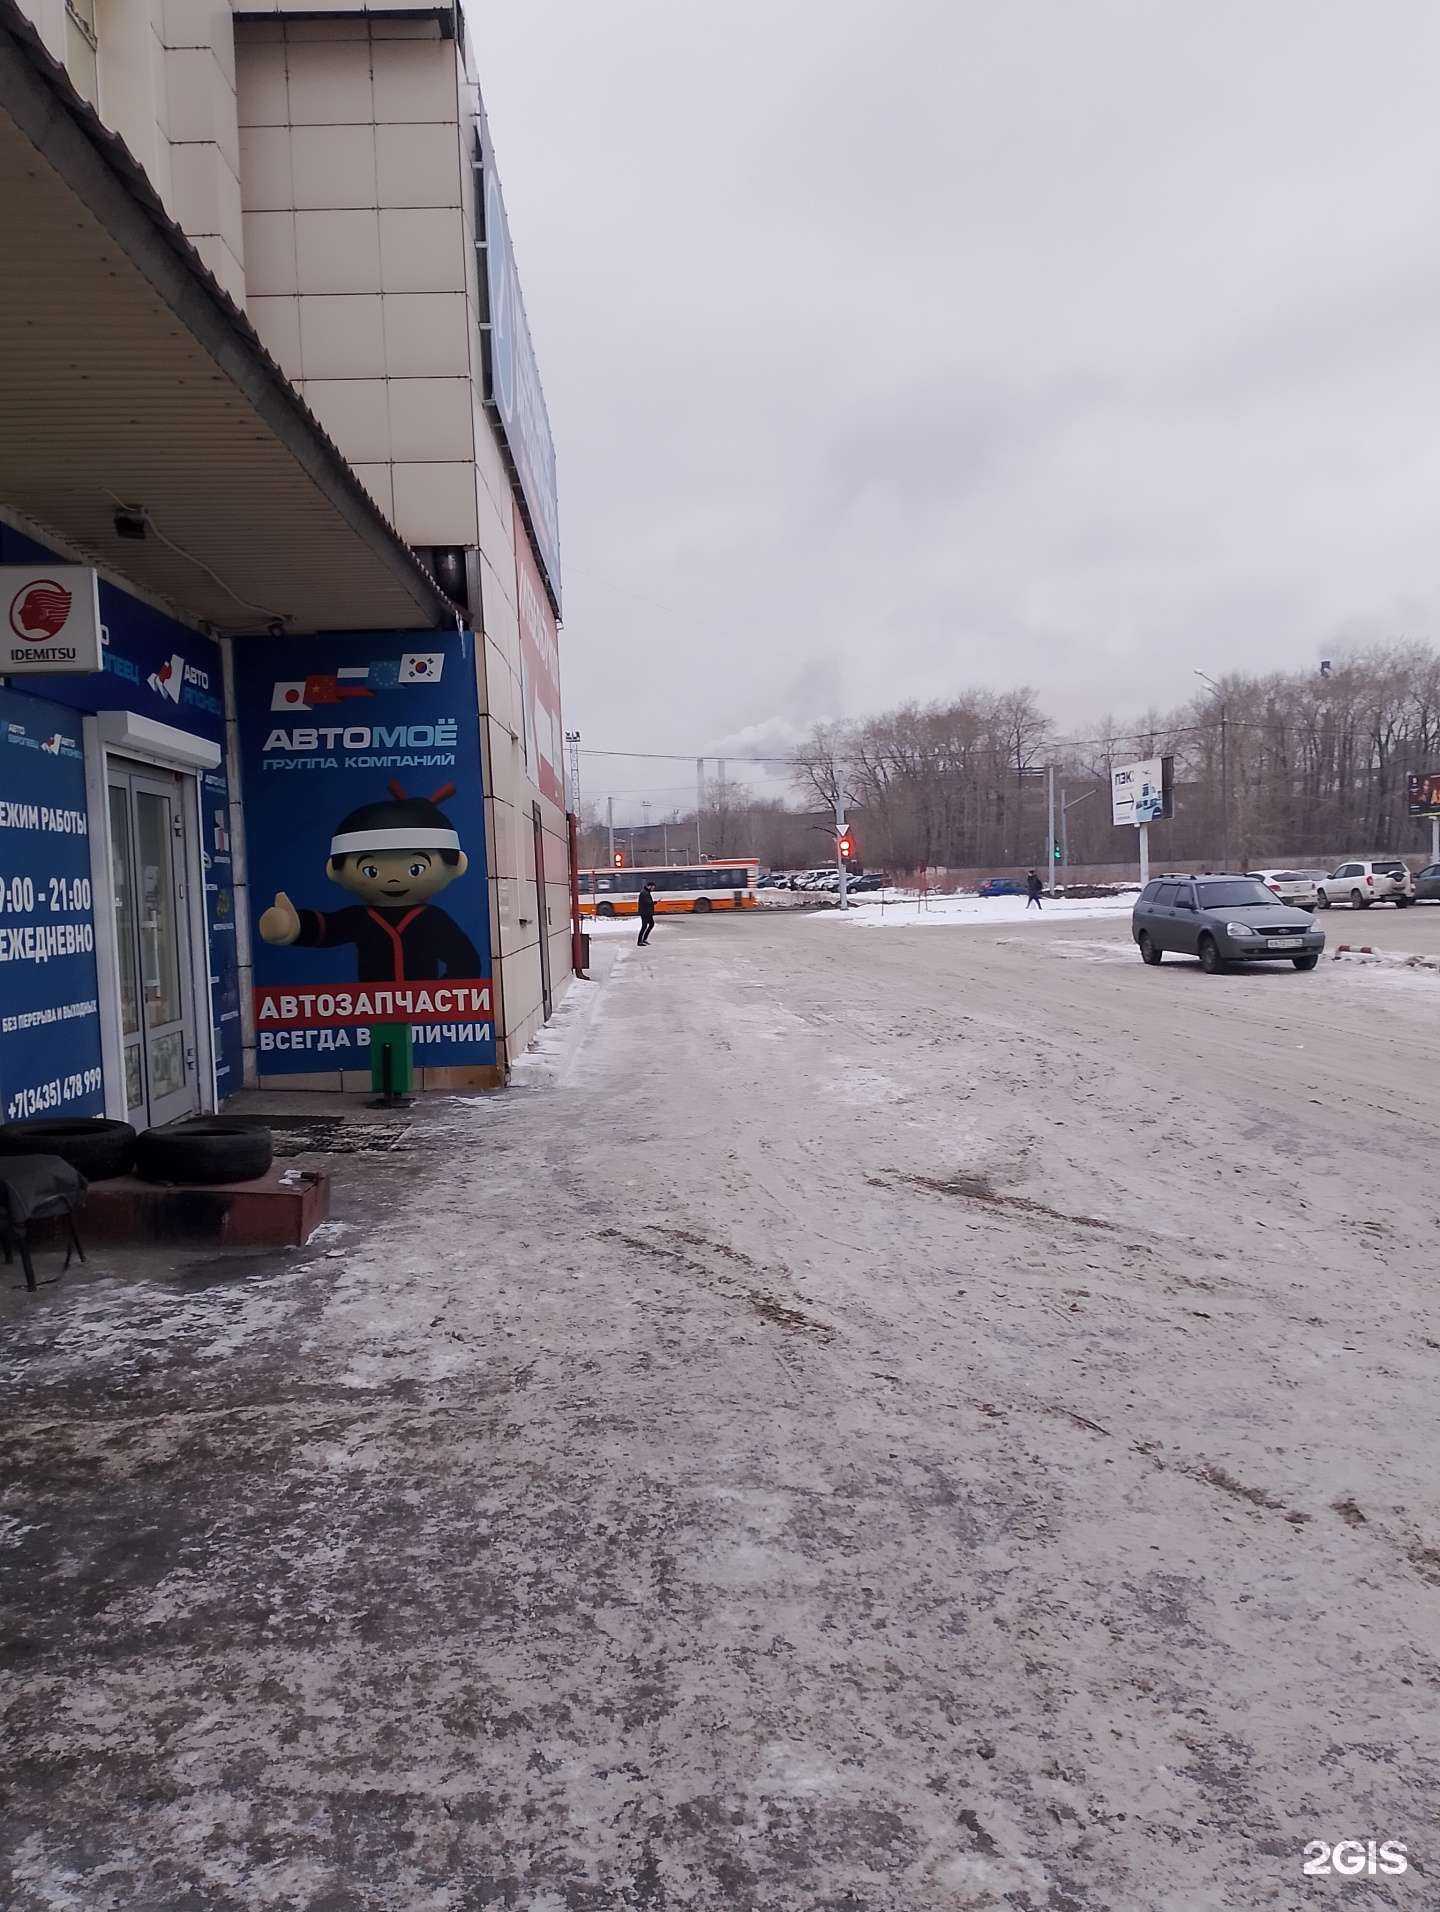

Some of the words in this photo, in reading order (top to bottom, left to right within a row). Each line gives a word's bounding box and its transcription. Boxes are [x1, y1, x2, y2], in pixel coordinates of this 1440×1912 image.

[11, 648, 76, 660] IDEMITSU
[184, 665, 208, 690] АВТО
[262, 718, 457, 751] АВТОМОЁ
[263, 757, 339, 770] ГРУППА
[345, 752, 455, 768] КОМПАНИЙ
[41, 807, 87, 835] РАБОТЫ
[50, 878, 91, 911] 21:00
[0, 924, 93, 963] ЕЖЕДНЕВНО
[259, 989, 490, 1019] АВТОЗАПЧАСТИ
[2, 1016, 17, 1032] БЕЗ
[18, 1008, 56, 1029] ПЕРЕРЫВА
[260, 1029, 351, 1051] ВСЕГДА
[356, 1028, 371, 1046] В
[412, 1023, 490, 1044] ЛИЧИИ
[8, 1078, 61, 1119] +7(3435)
[63, 1073, 83, 1100] 478
[84, 1067, 101, 1094] 999
